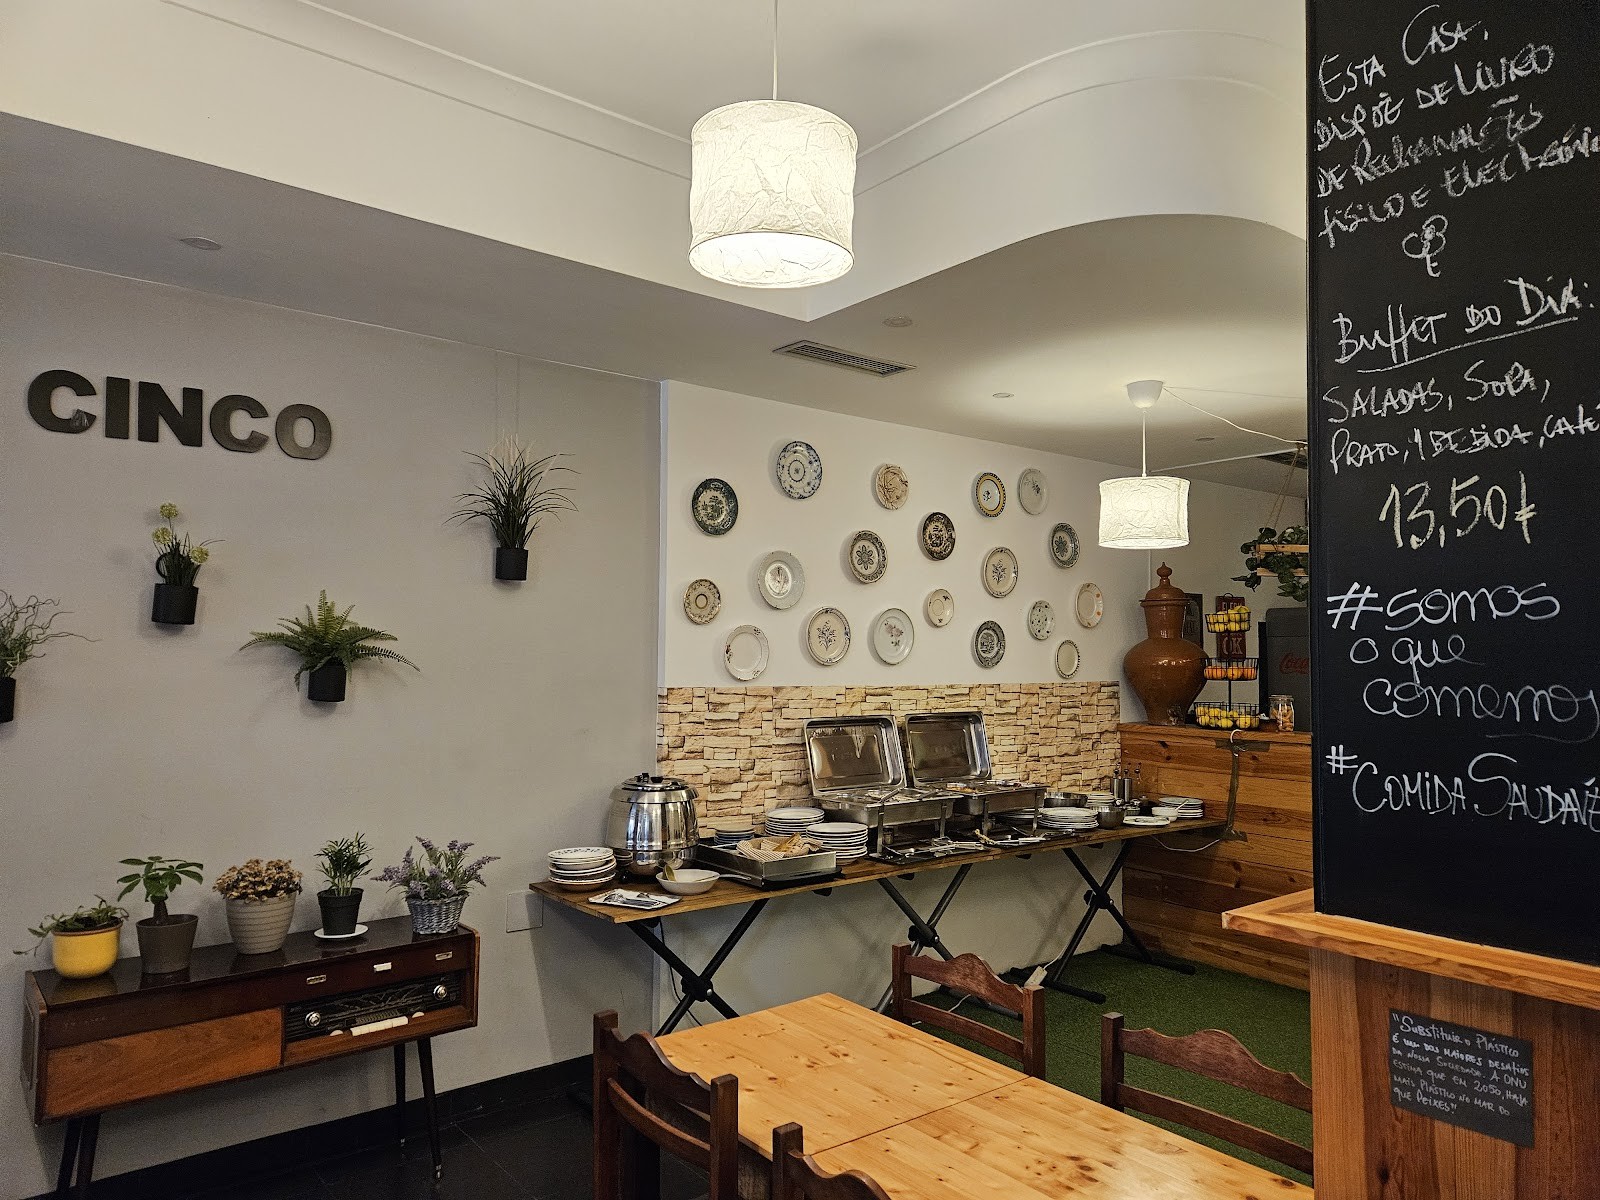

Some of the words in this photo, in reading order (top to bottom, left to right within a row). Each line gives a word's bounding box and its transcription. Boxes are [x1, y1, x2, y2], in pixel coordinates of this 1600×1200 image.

[1416, 81, 1452, 109] DE
[1317, 164, 1348, 197] DE
[1465, 303, 1501, 333] DO
[27, 369, 332, 460] CINCO
[1391, 634, 1486, 698] que
[1490, 1070, 1500, 1082] A
[1503, 1074, 1527, 1089] ONU
